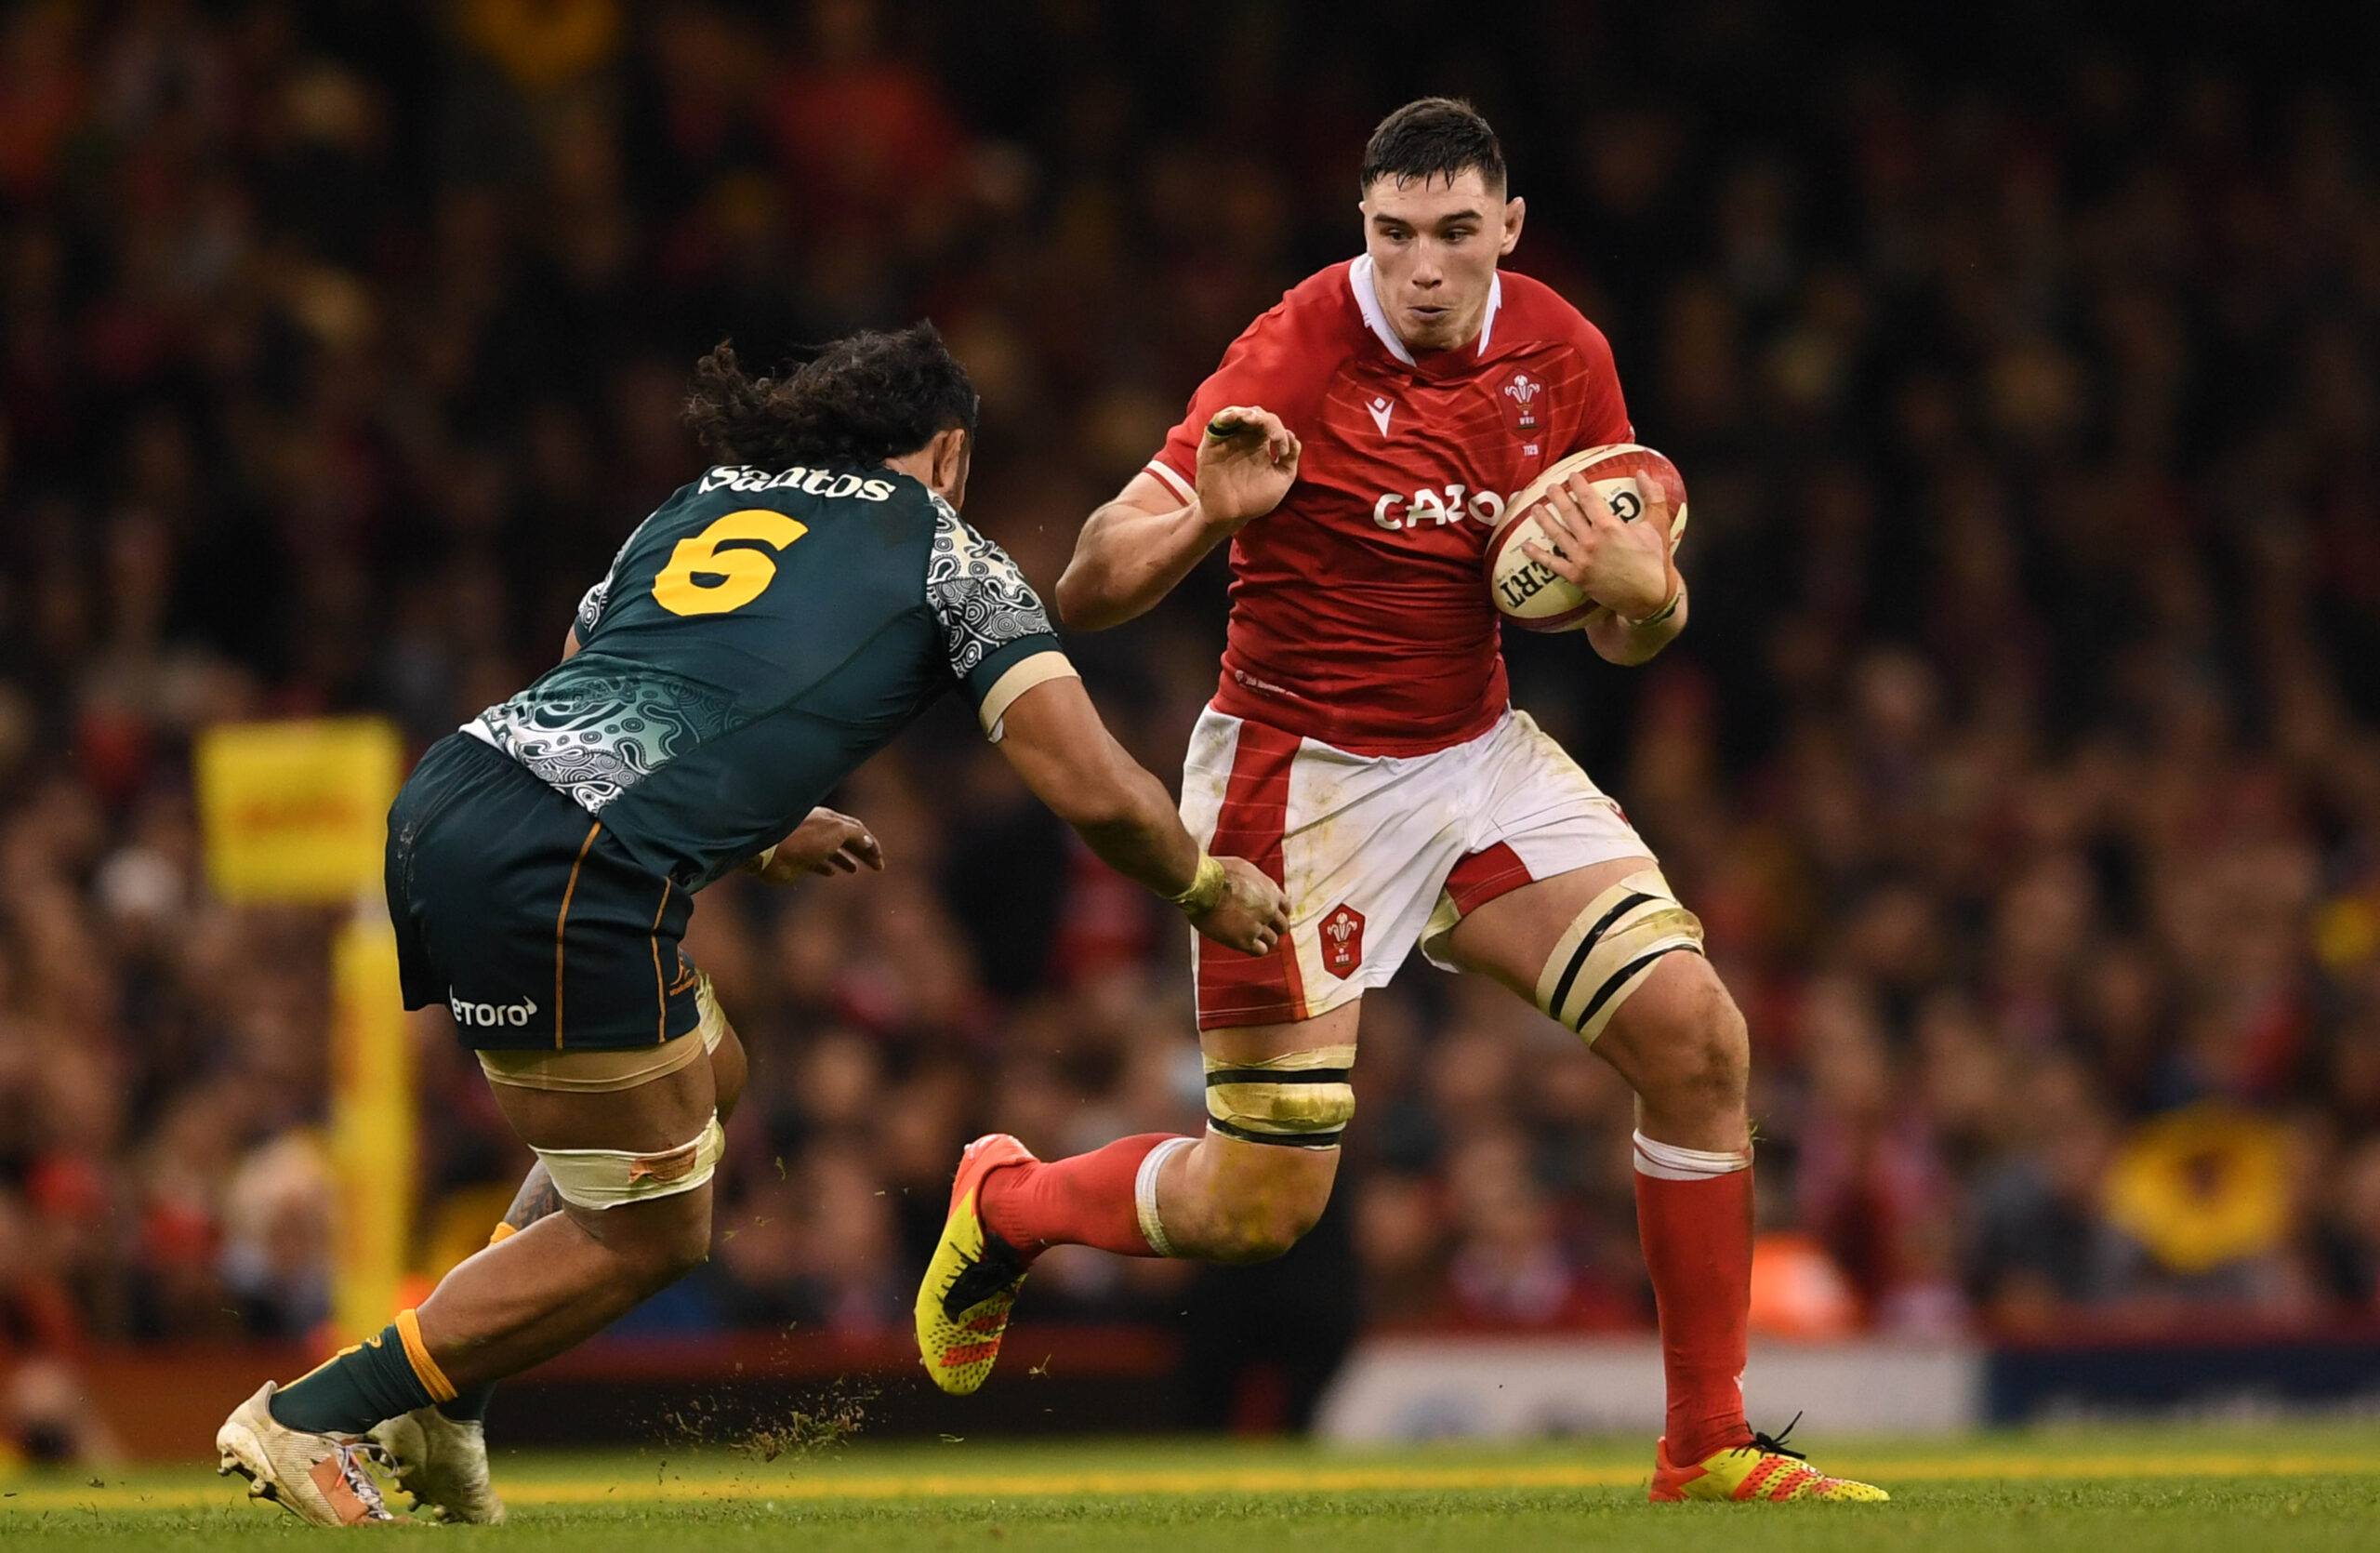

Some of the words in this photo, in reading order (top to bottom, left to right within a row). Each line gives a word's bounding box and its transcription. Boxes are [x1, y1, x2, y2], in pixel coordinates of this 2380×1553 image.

[698, 465, 897, 502] Santos
[1373, 484, 1523, 530] CAZO
[651, 509, 809, 617] 6
